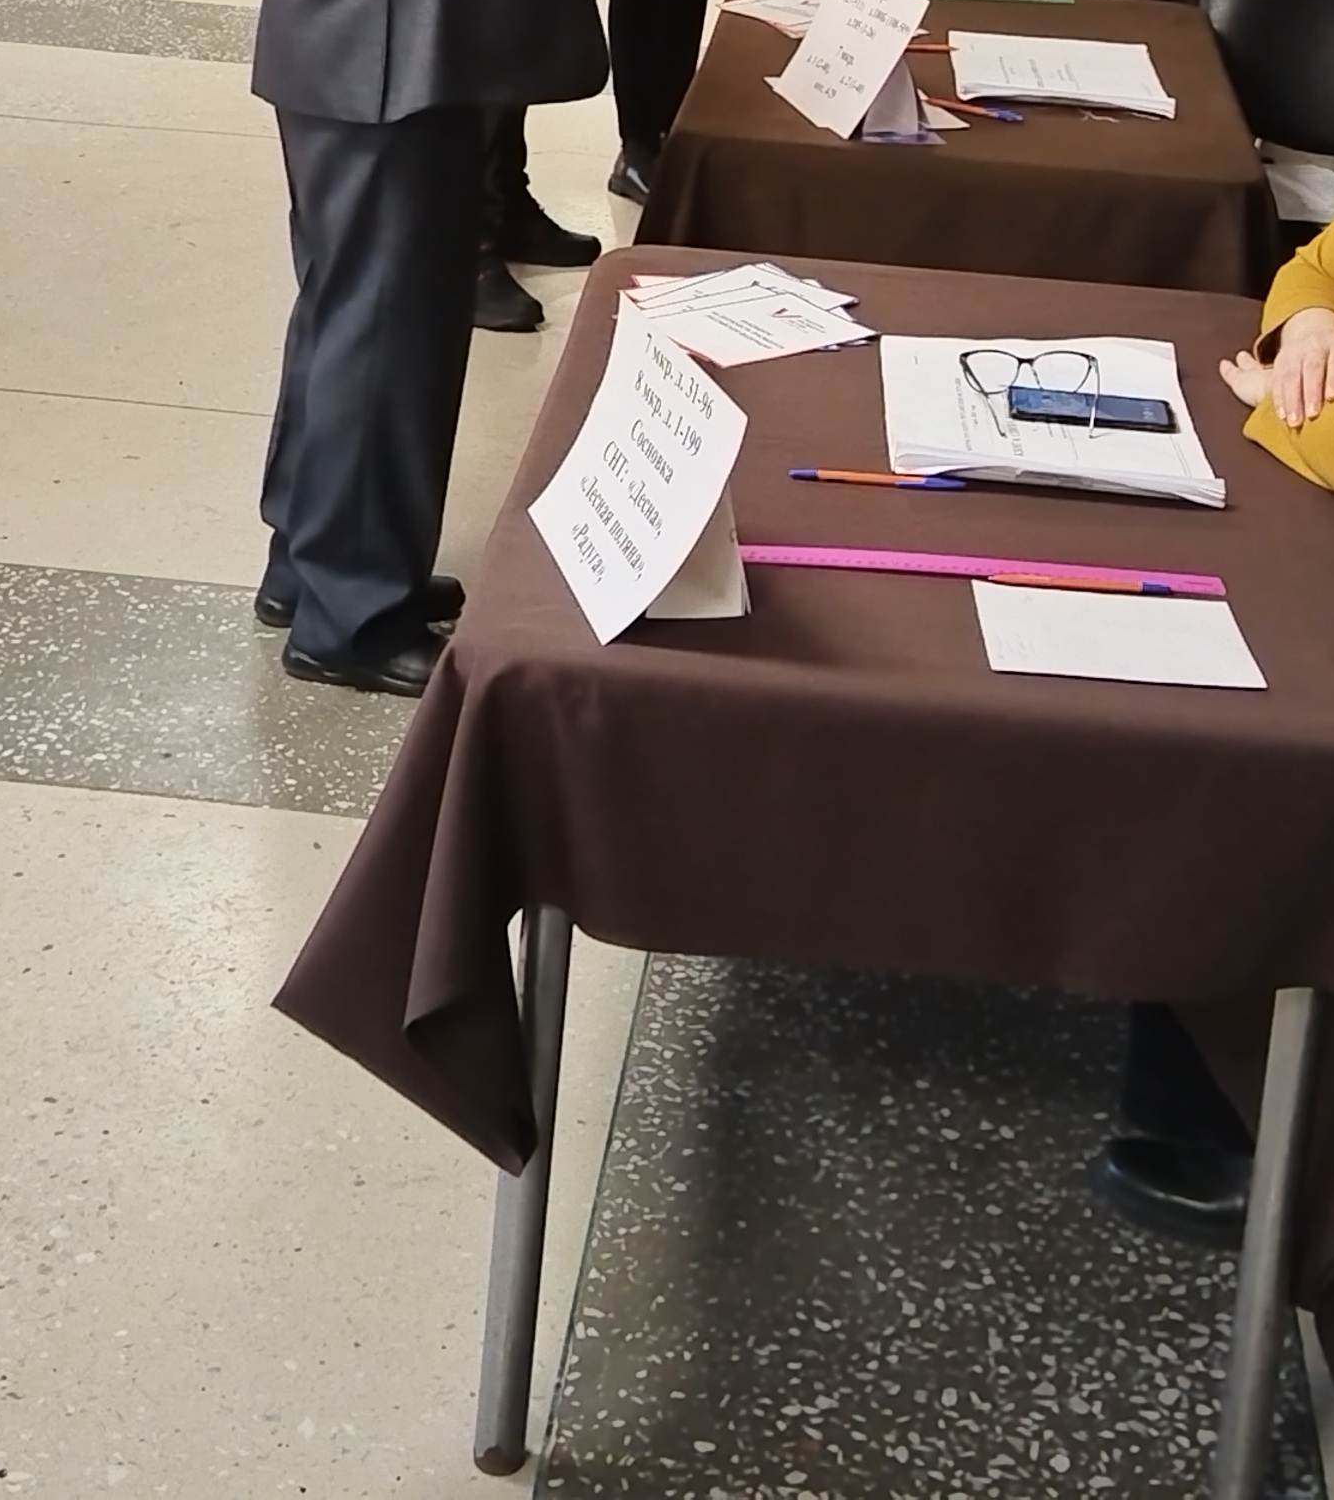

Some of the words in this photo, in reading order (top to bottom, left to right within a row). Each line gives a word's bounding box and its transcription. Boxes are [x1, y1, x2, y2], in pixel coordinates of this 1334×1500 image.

[634, 369, 644, 391] 8
[642, 383, 662, 418] мкр.
[673, 415, 702, 457] 1-199
[645, 332, 652, 353] 7
[651, 346, 673, 380] мкр.
[685, 377, 714, 420] 31-96
[602, 441, 630, 483] СНТ:
[630, 419, 674, 485] Сосновка
